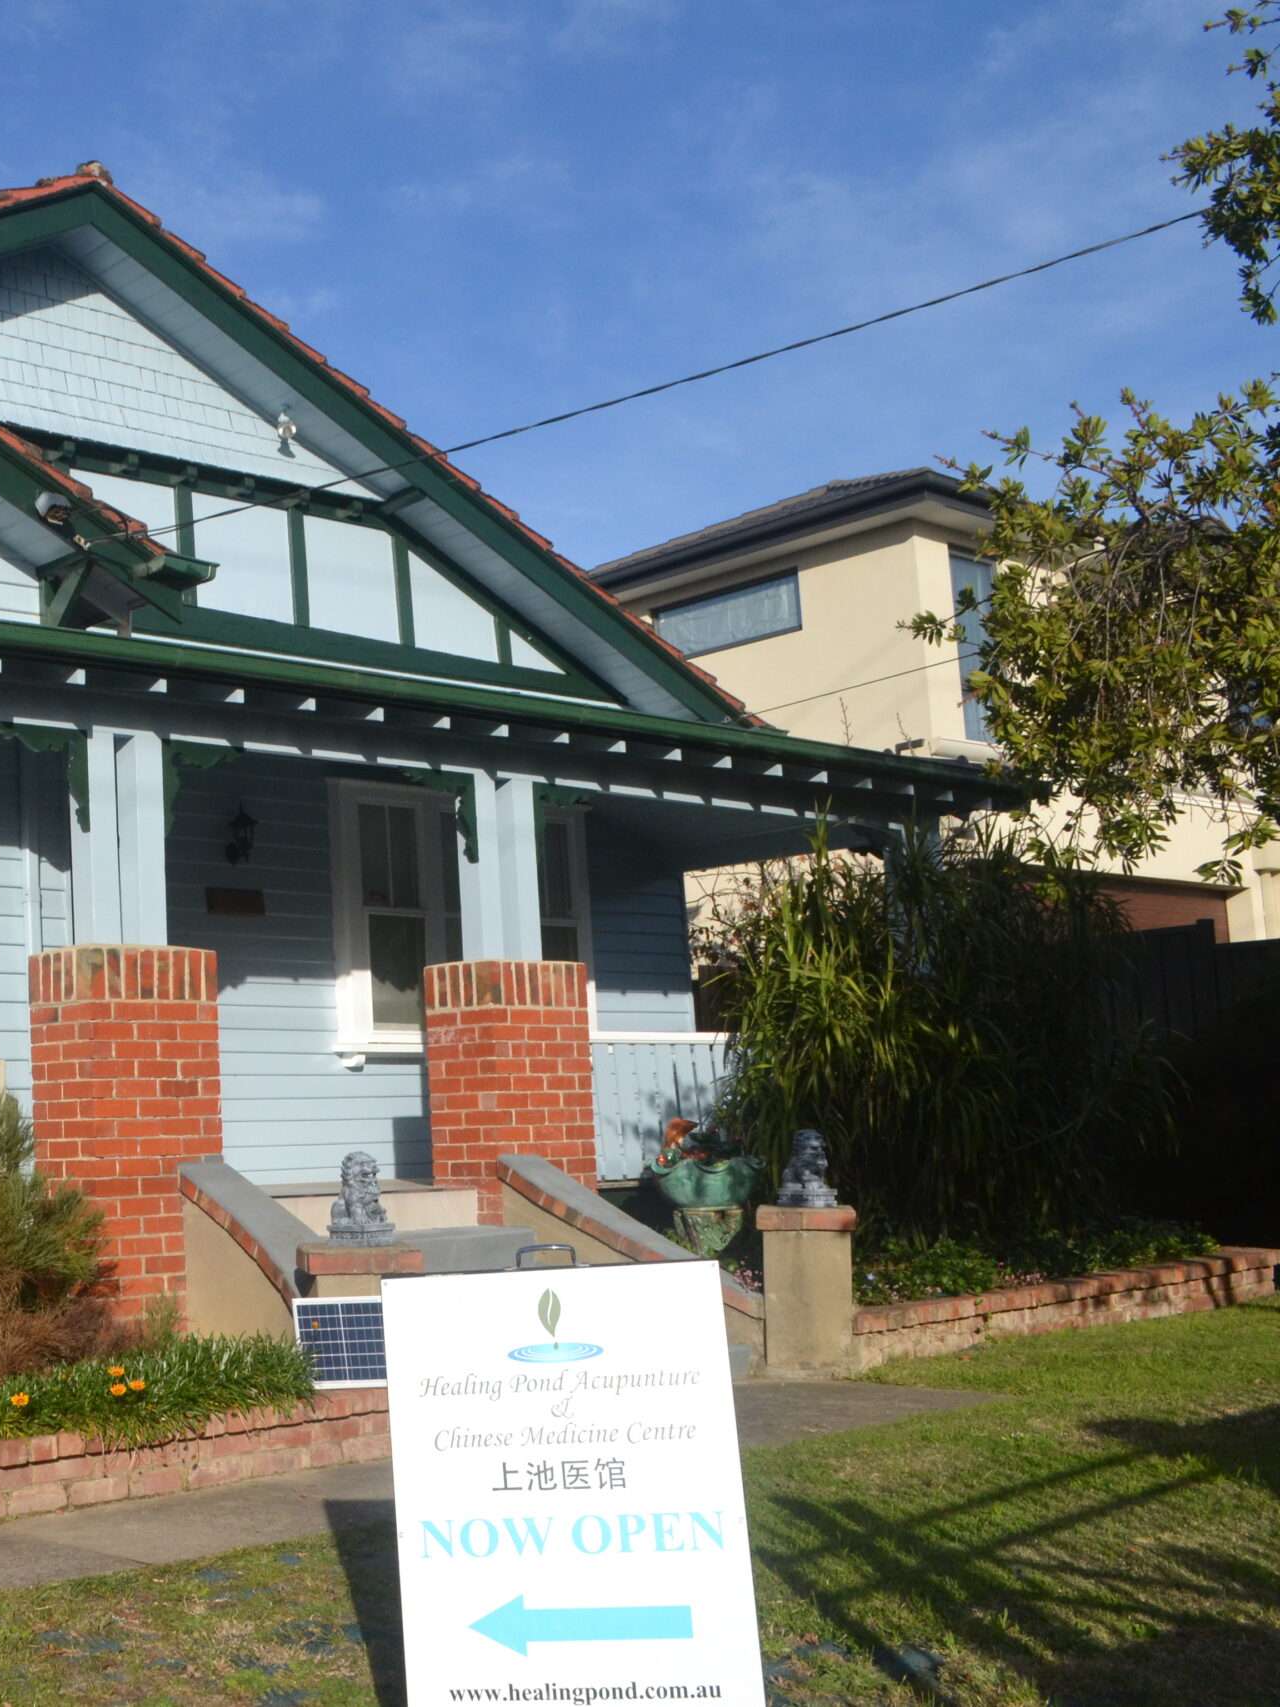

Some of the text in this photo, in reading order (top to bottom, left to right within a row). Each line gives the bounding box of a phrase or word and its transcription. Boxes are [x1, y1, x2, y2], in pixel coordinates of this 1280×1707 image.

[420, 1373, 502, 1401] Healing
[510, 1370, 565, 1392] Pond
[551, 1396, 574, 1419] &
[434, 1422, 696, 1451] Chinese Medicine Centre
[492, 1457, 625, 1491] 上池医馆
[421, 1511, 723, 1558] NOW OPEN
[450, 1682, 721, 1705] www.healingpond.com.au
